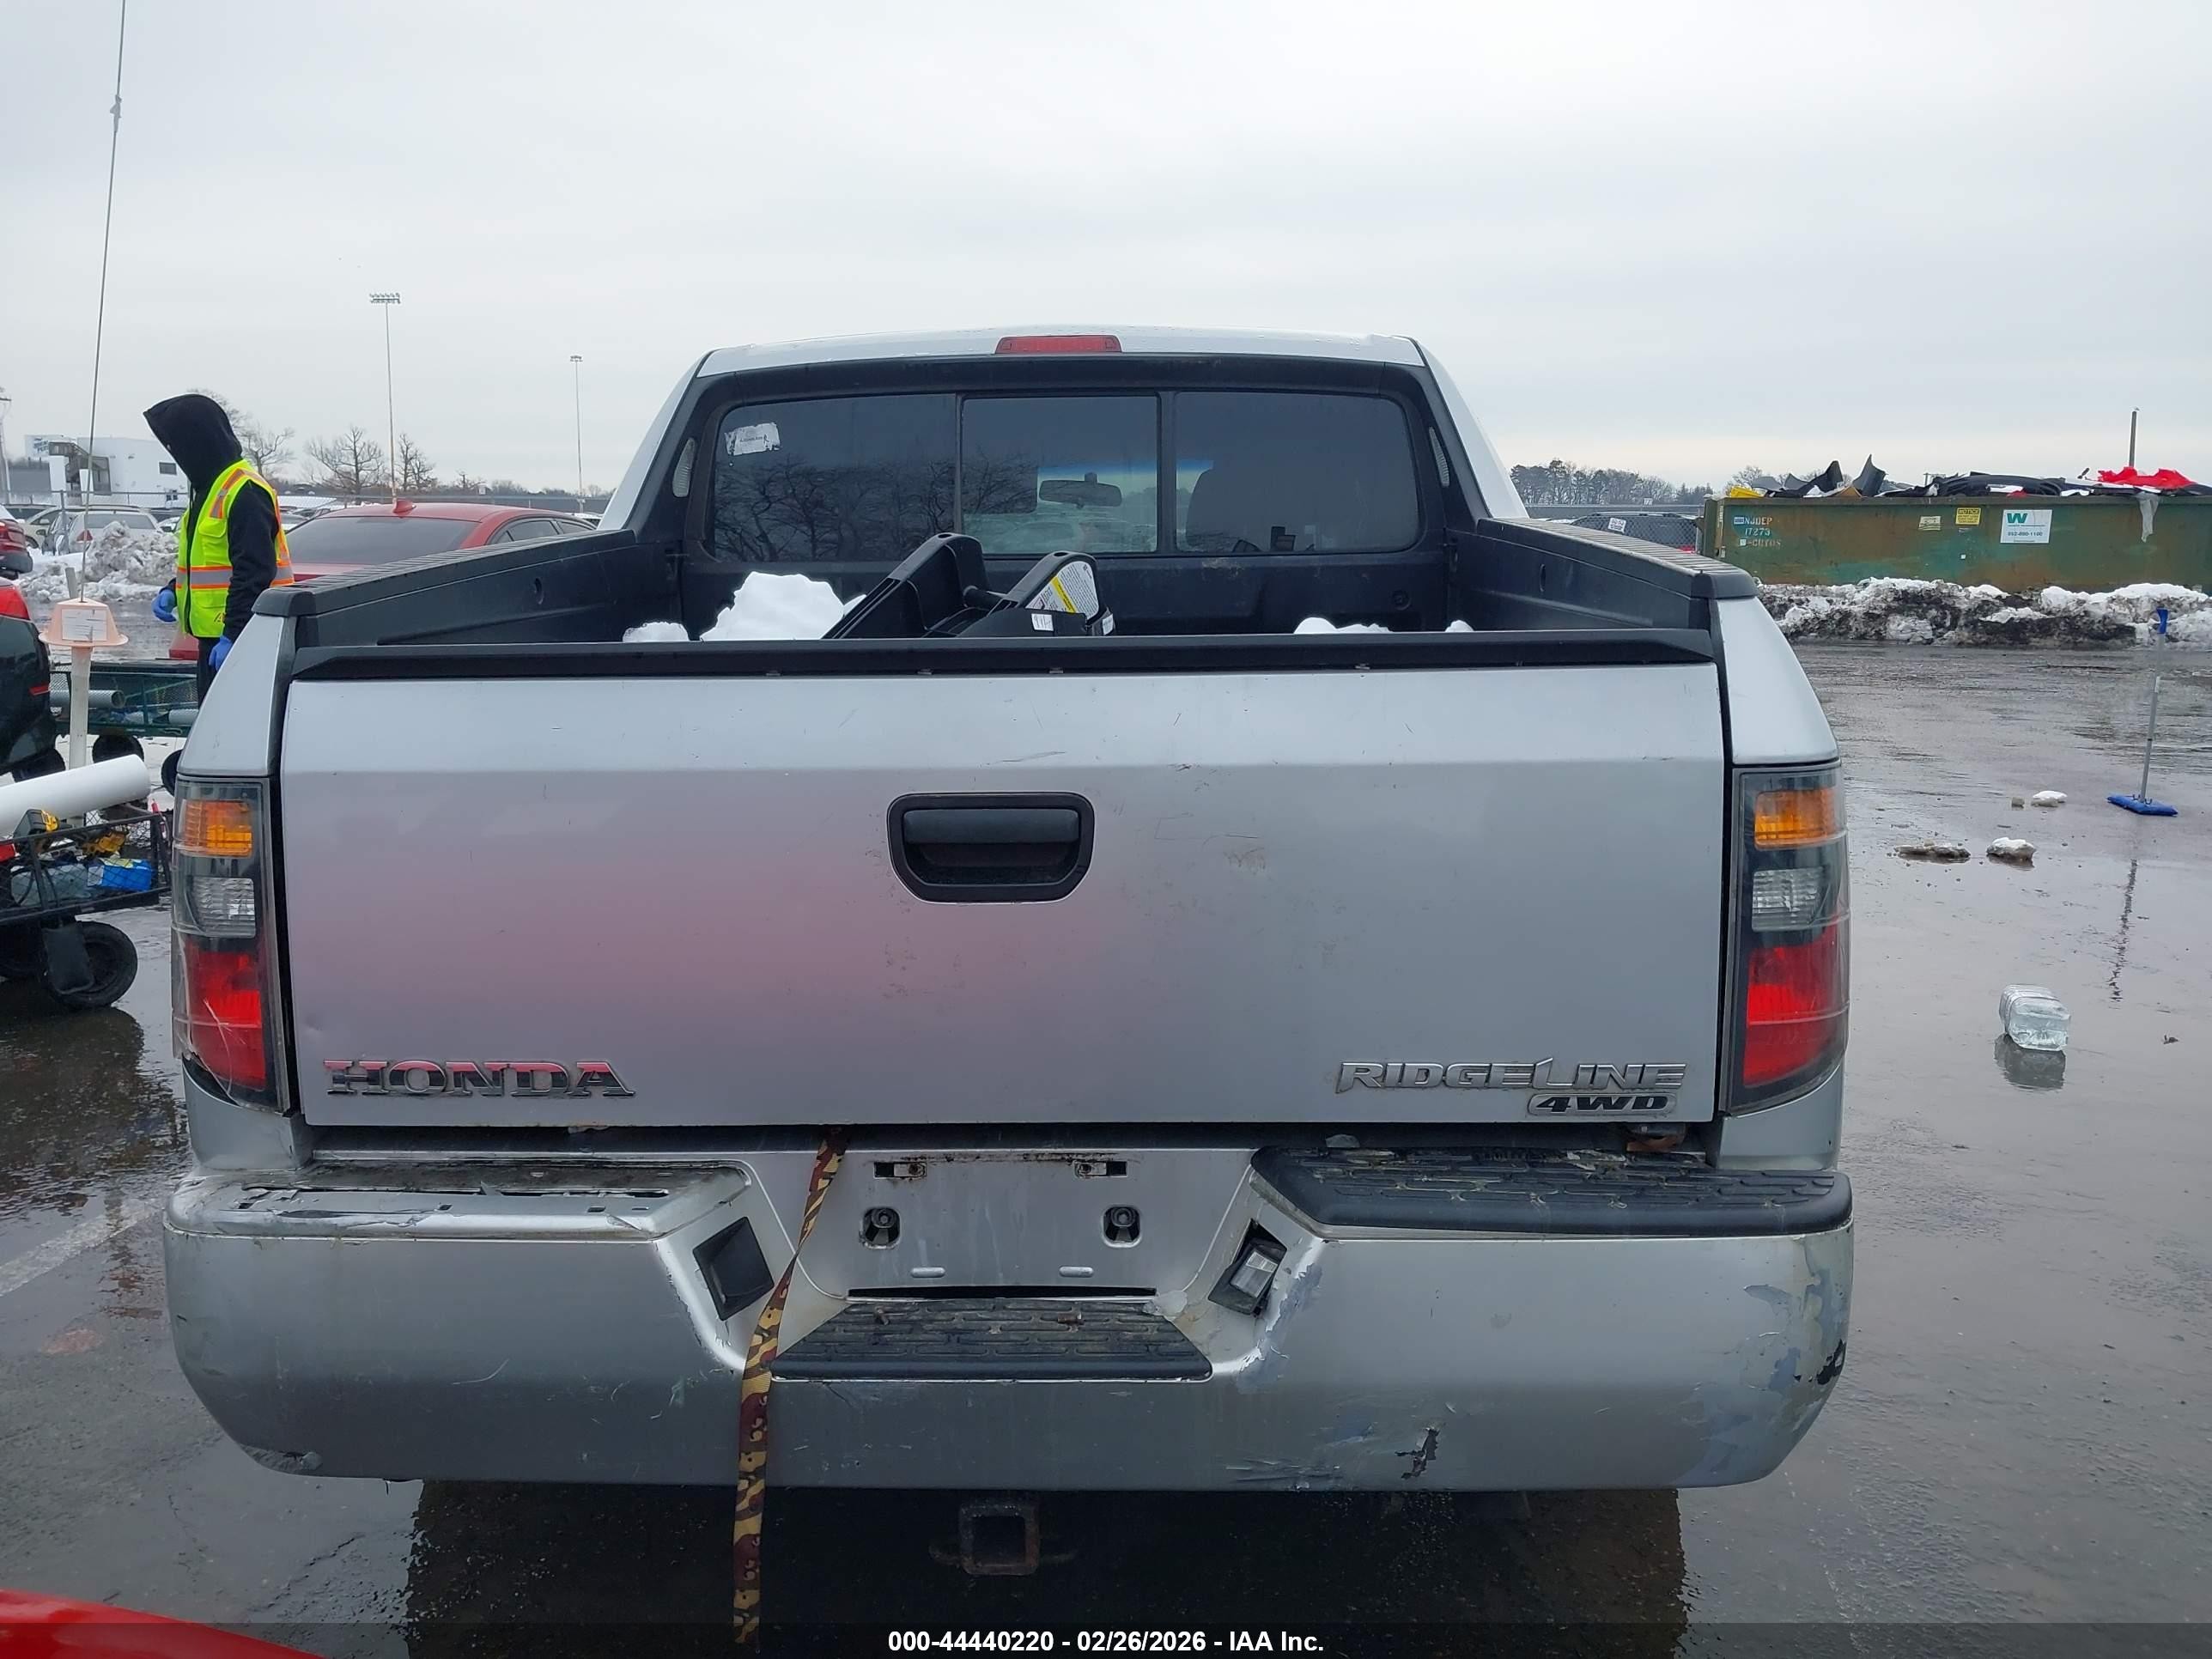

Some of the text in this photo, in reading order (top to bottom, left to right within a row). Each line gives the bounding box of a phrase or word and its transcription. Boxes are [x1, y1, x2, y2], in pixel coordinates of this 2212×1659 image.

[1744, 517, 1773, 526] NJDEP
[323, 1060, 636, 1097] HONDA
[1335, 1057, 1687, 1093] RIDGELINE
[1535, 1095, 1668, 1114] 4WD
